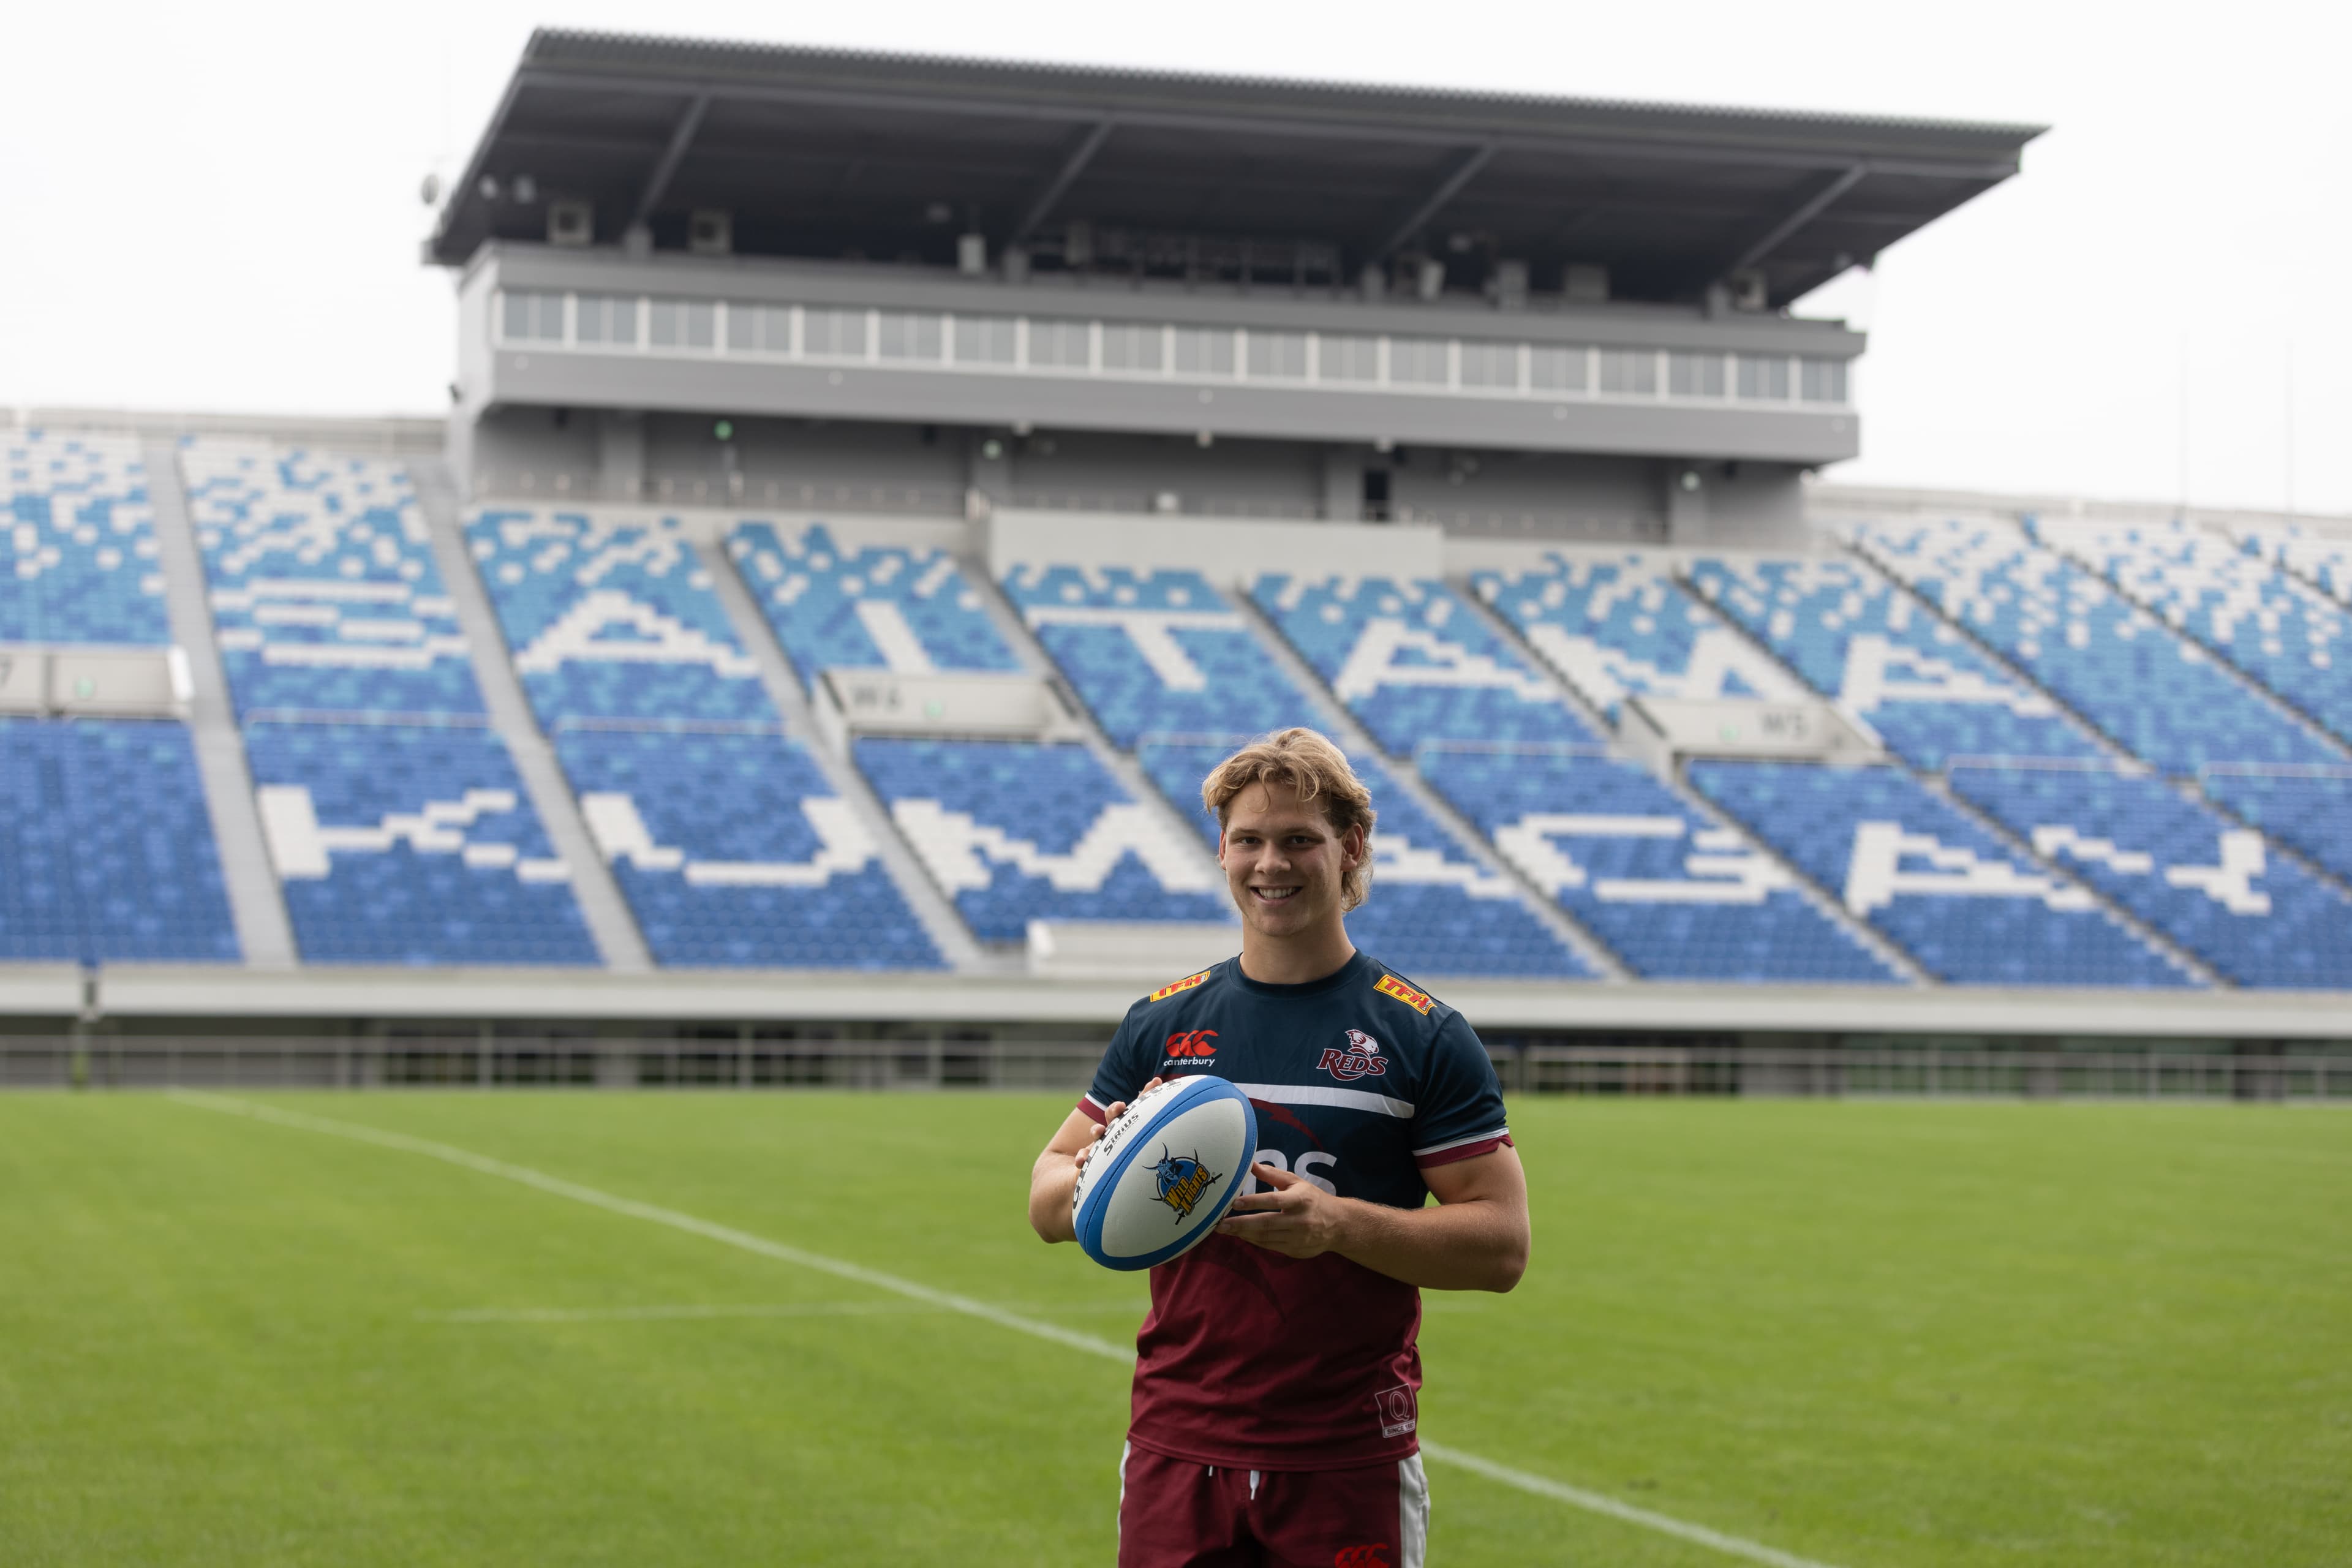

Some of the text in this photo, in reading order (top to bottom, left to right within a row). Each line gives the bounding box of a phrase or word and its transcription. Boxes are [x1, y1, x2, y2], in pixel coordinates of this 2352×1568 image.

[1384, 978, 1431, 1009] TFH
[1164, 1057, 1216, 1067] canterbury
[1387, 1425, 1404, 1435] SINCE
